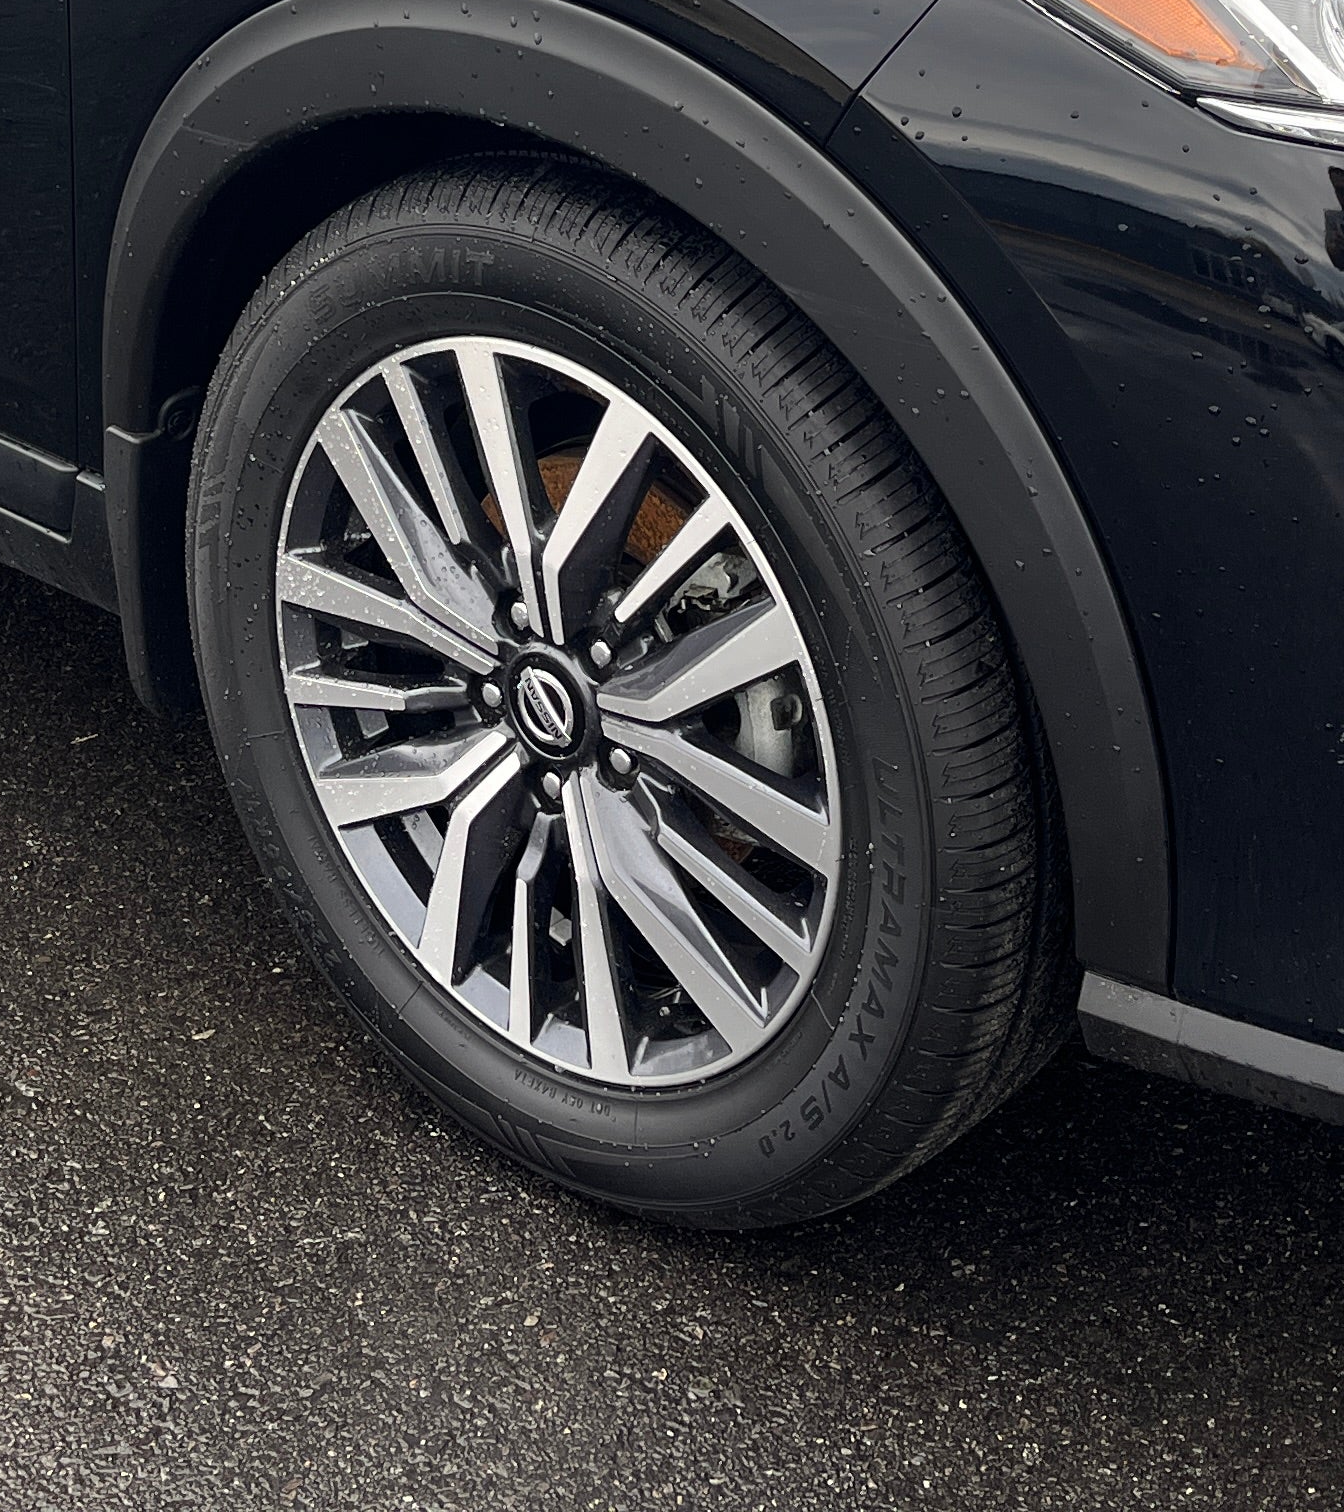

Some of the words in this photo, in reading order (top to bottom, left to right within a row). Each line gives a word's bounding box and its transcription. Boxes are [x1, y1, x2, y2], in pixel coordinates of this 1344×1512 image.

[524, 677, 563, 740] NISSAN
[848, 754, 908, 1061] ULTRAMAX
[800, 1054, 851, 1131] A/S
[759, 1119, 797, 1159] 2.0
